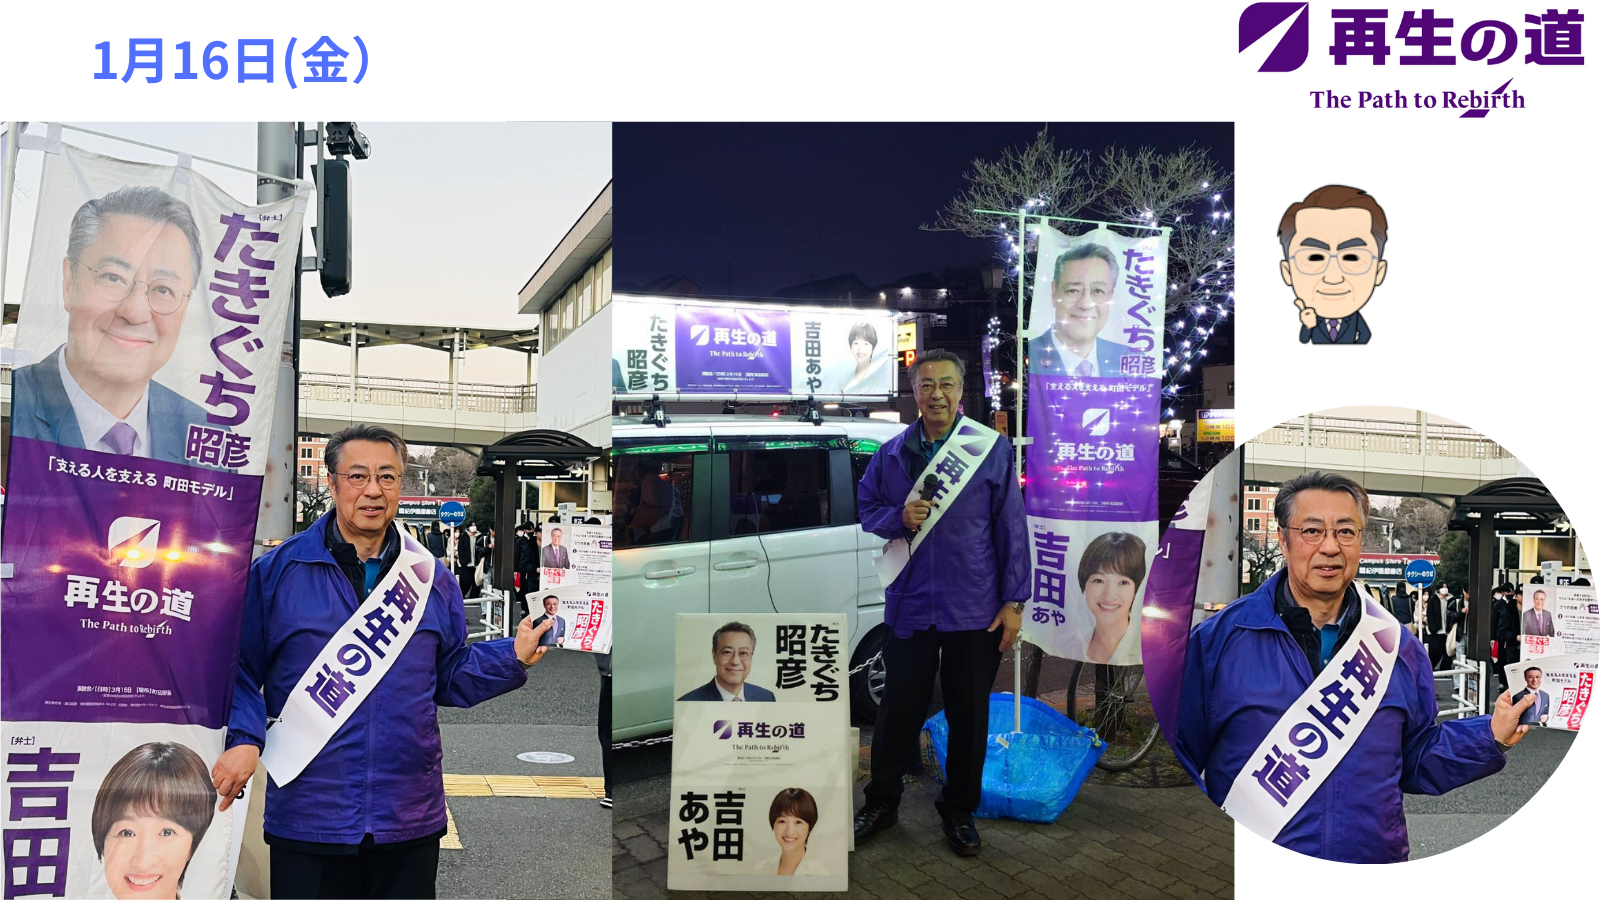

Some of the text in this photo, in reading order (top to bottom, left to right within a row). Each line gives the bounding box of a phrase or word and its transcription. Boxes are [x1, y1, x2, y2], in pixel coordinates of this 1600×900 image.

[199, 212, 280, 427] たきぐち
[1122, 248, 1156, 353] たきぐち
[649, 314, 669, 392] たきぐち
[713, 327, 777, 347] 再生の道
[743, 350, 763, 359] Rebirth
[804, 321, 822, 394] 吉田あや
[627, 349, 648, 391] 昭彦
[1120, 354, 1156, 375] 昭彦
[184, 425, 252, 470] 昭彦
[1056, 442, 1135, 462] 再生の道
[48, 456, 234, 501] 「支える人を支える 町田モデル」
[1032, 531, 1070, 609] 吉田
[64, 574, 195, 622] 再生の道
[1032, 606, 1066, 627] あや
[80, 618, 172, 637] The Path to Rebirth
[304, 571, 420, 719] 再生の道
[582, 601, 603, 646] たきぐち
[775, 624, 807, 690] 昭彦
[810, 623, 840, 702] たきぐち
[1251, 639, 1383, 808] 再生の道
[1570, 673, 1592, 726] たきぐち
[732, 743, 743, 751] The
[745, 743, 759, 751] Path
[737, 721, 806, 739] 再生の道
[3, 746, 81, 900] 吉田
[678, 791, 710, 861] あや
[713, 790, 746, 861] 吉田
